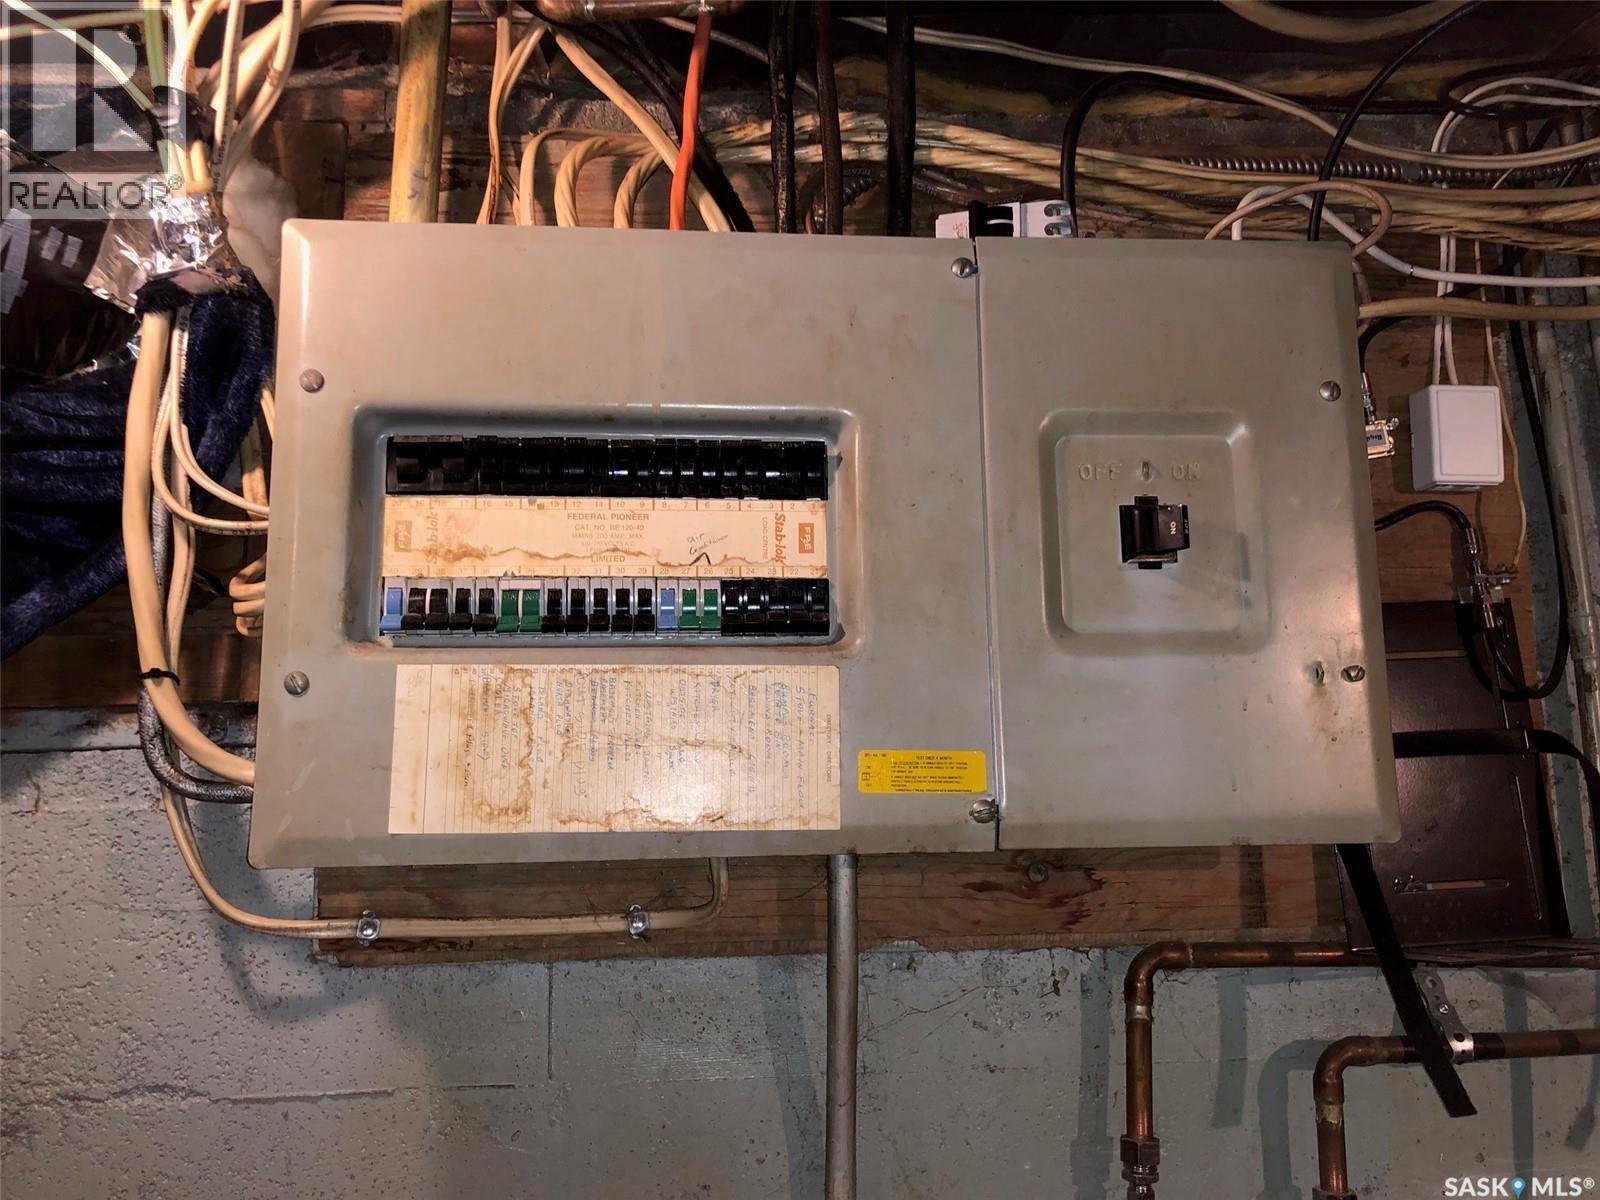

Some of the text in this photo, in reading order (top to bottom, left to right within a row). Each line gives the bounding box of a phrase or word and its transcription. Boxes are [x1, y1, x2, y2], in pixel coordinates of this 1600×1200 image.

[1077, 463, 1201, 480] OFF ON
[567, 513, 650, 521] FEDERAL PIONEER
[1170, 521, 1176, 535] ON
[774, 512, 786, 563] Stab-lok
[591, 555, 626, 563] LIMITED
